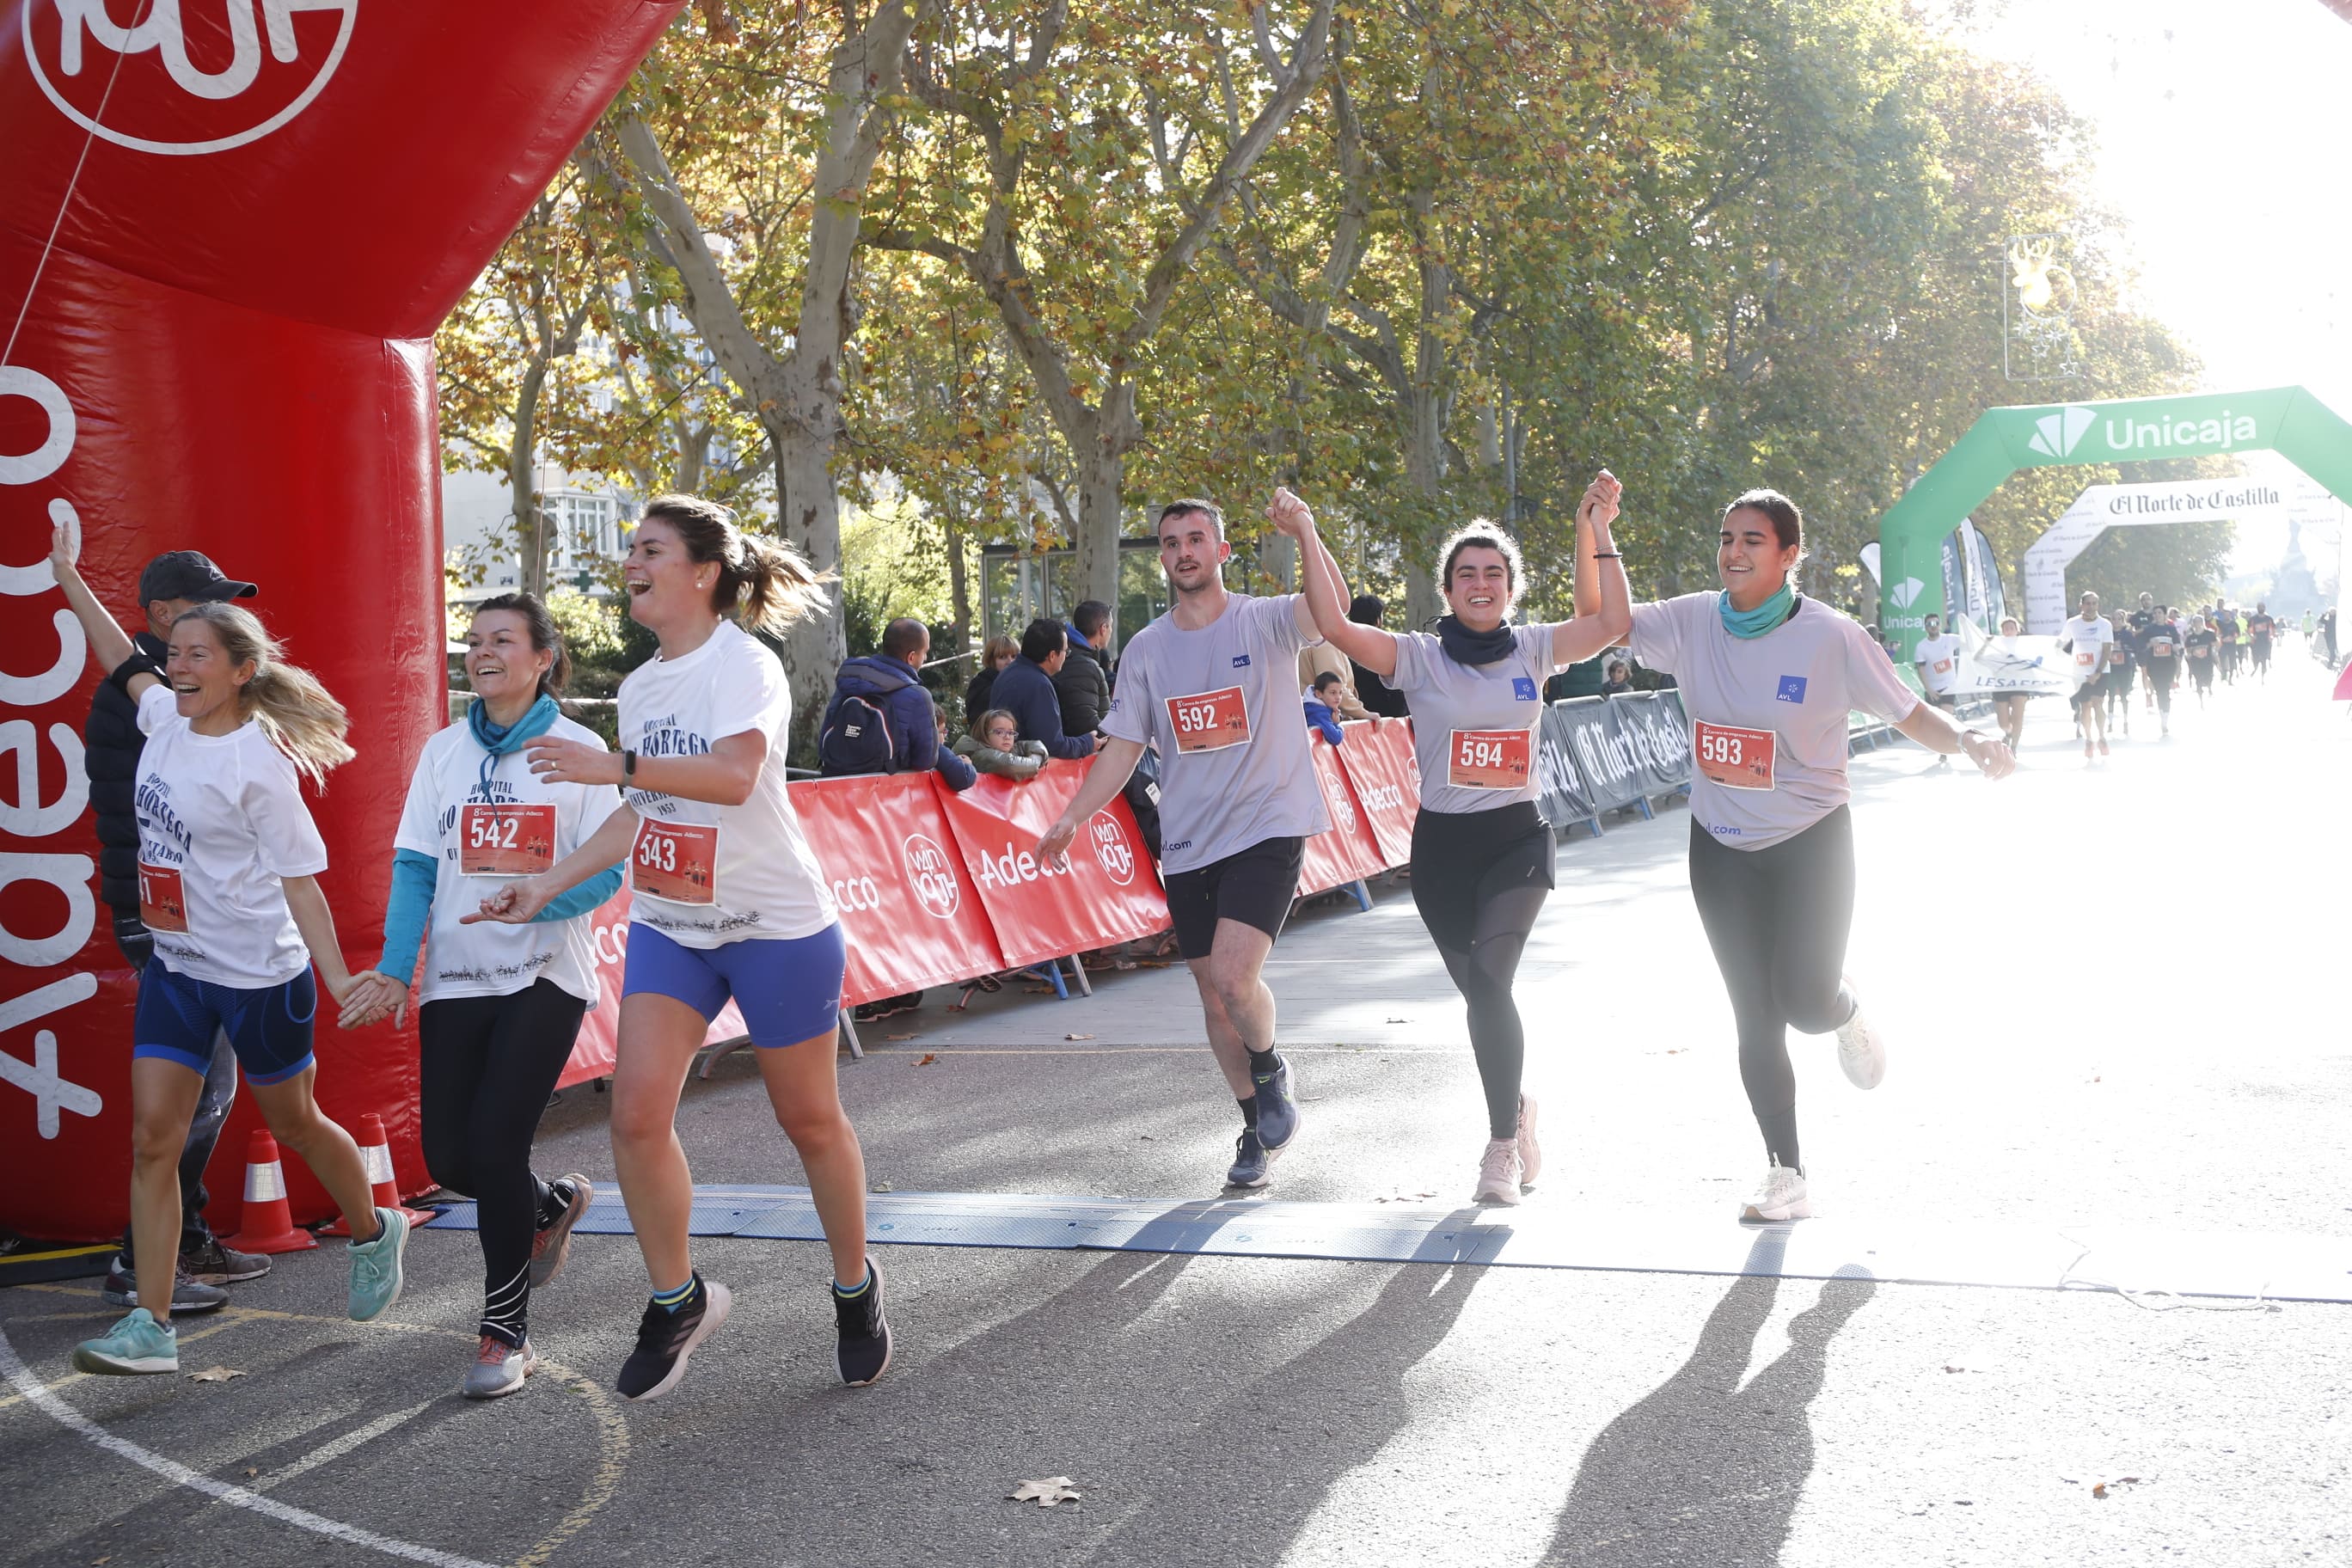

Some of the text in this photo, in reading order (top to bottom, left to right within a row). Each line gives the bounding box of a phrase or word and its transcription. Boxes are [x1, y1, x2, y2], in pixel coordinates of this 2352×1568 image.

[2106, 410, 2257, 450] Unicaja
[2110, 487, 2280, 515] El Norte de Castilla
[1883, 613, 1926, 632] Unicaj
[1178, 704, 1217, 732] 592
[1461, 740, 1503, 767] 594
[1702, 735, 1742, 765] 593
[470, 781, 513, 795] HOPITAL
[1361, 781, 1403, 812] Adecco
[137, 784, 192, 854] HORTEGA
[657, 802, 677, 816] 1953
[470, 818, 519, 848] 542
[640, 833, 676, 872] 543
